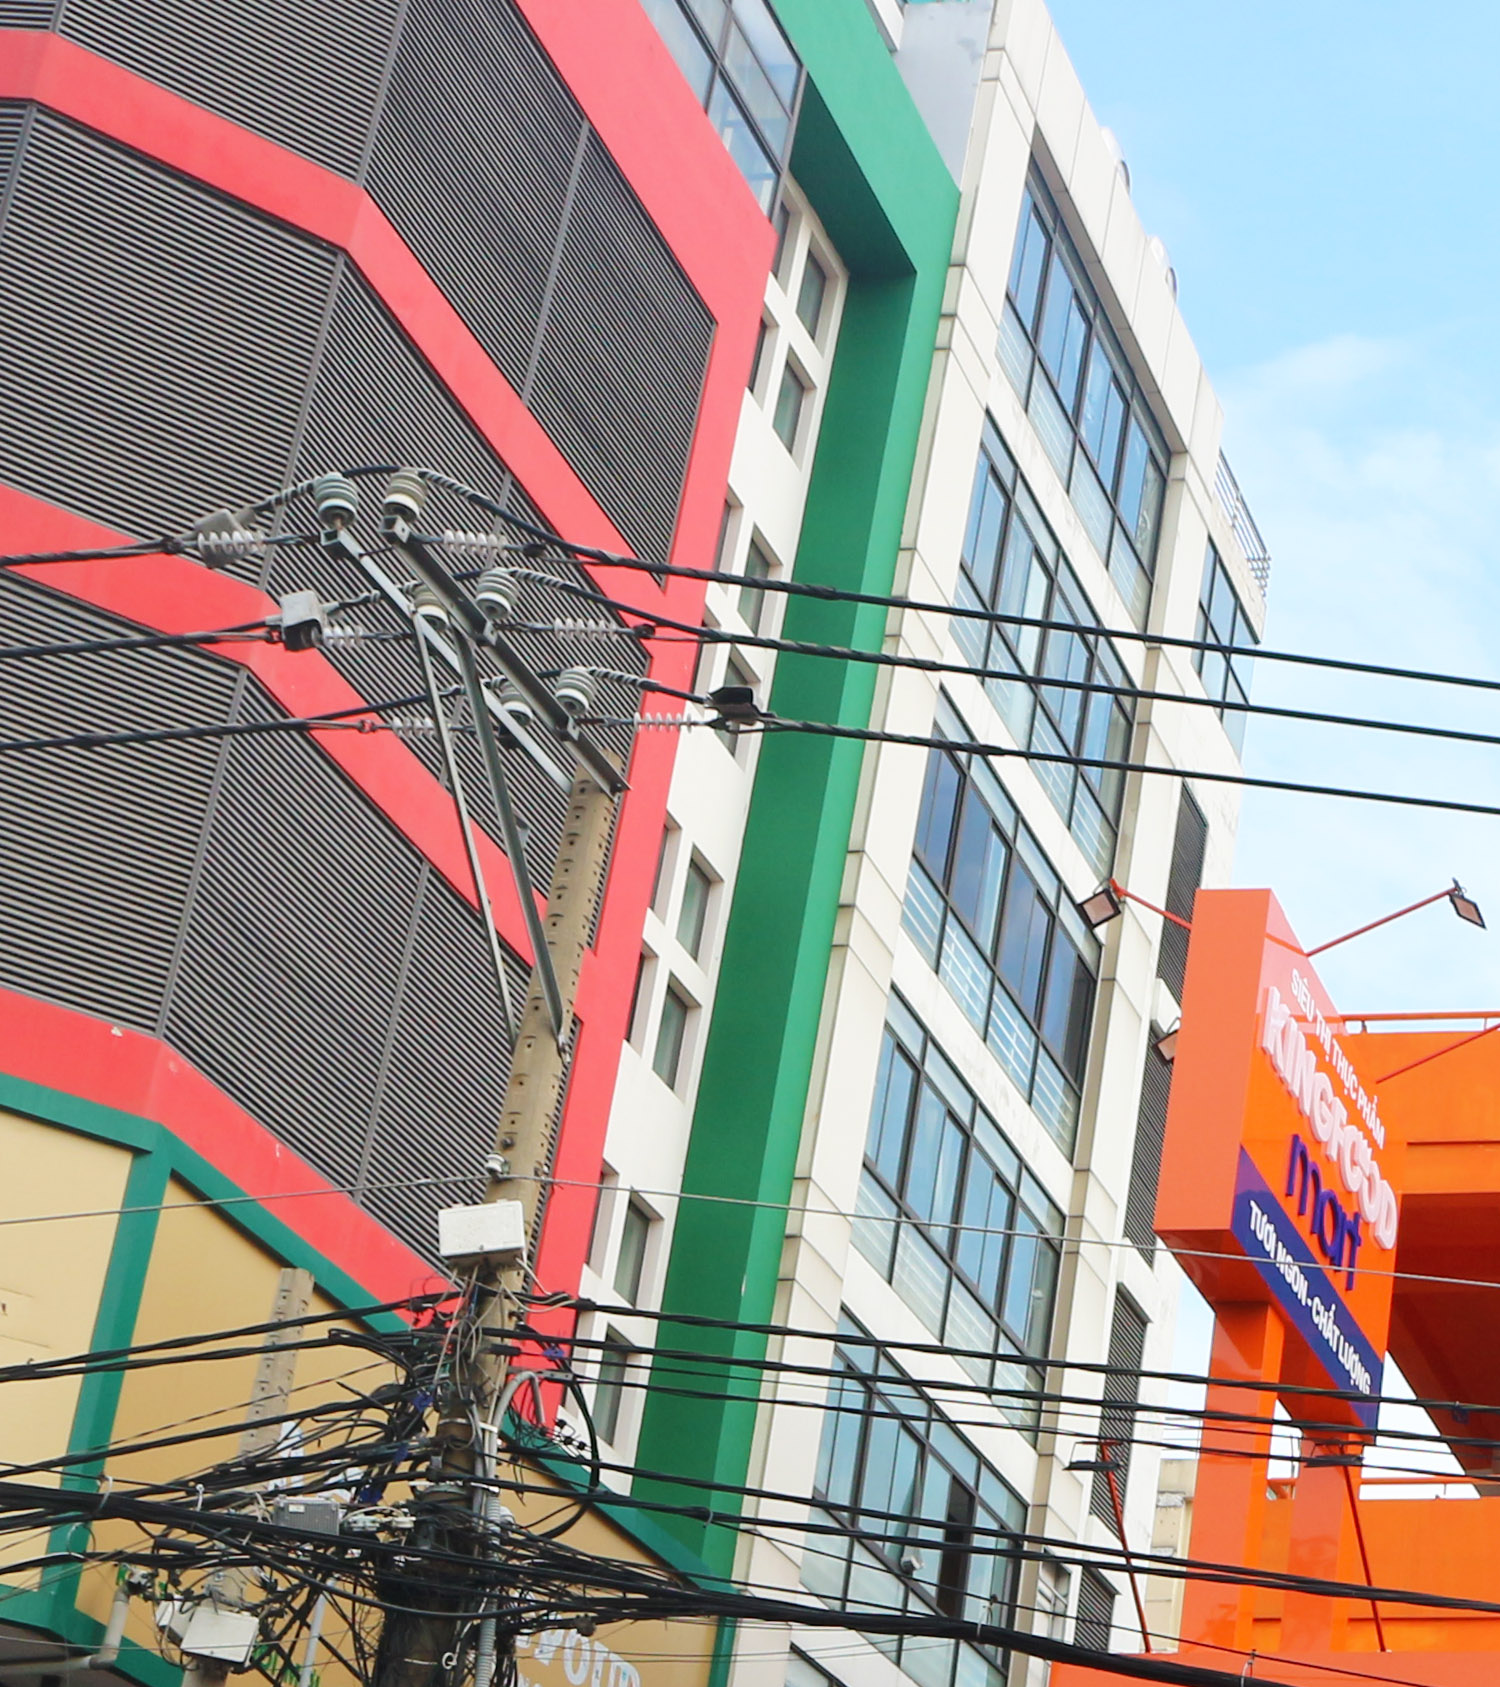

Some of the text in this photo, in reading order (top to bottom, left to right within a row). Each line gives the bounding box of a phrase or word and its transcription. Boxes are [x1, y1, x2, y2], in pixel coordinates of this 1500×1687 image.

[1291, 968, 1315, 1022] SIÊU
[1332, 1036, 1357, 1099] THỰC
[1357, 1096, 1385, 1149] PHẨM
[1249, 1199, 1372, 1396] TƯƠI NGON CHẤT LƯỢNG
